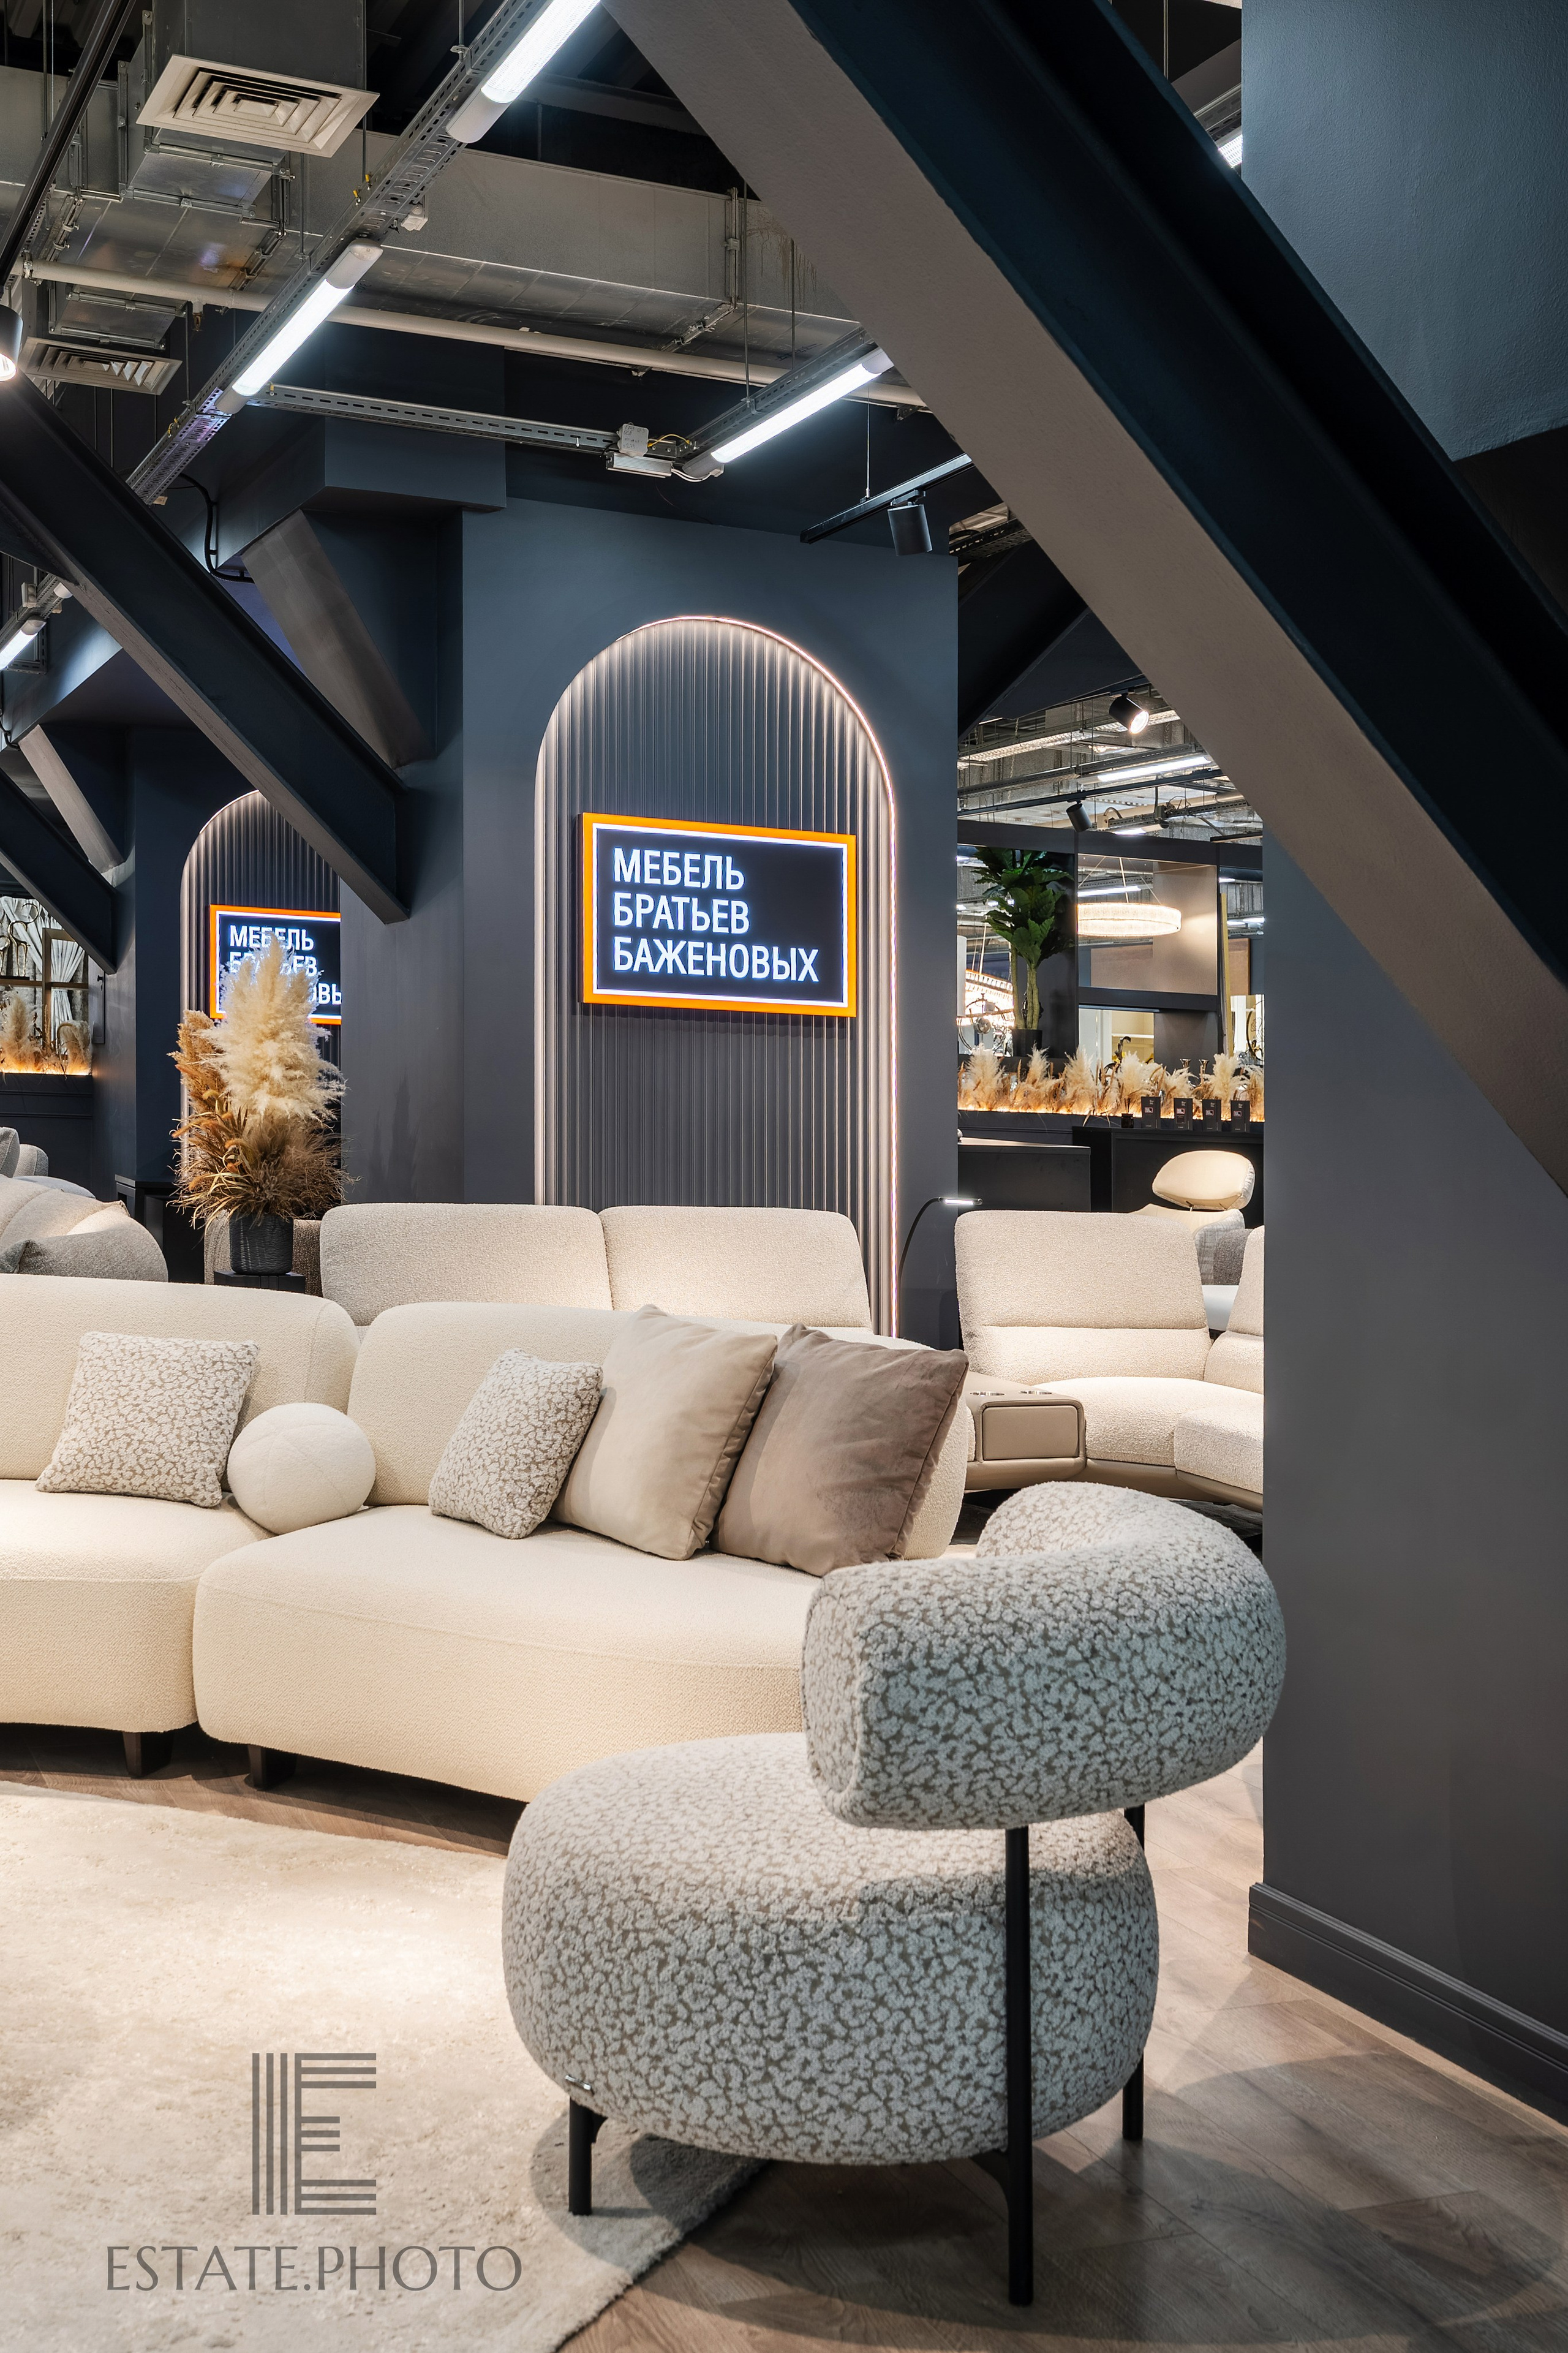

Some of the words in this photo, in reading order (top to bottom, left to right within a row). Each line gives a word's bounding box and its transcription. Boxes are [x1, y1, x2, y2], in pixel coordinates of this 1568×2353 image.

[614, 847, 745, 890] МЕБЕЛЬ
[614, 892, 750, 934] БРАТЬЕВ
[614, 936, 820, 982] БАЖЕНОВЫХ
